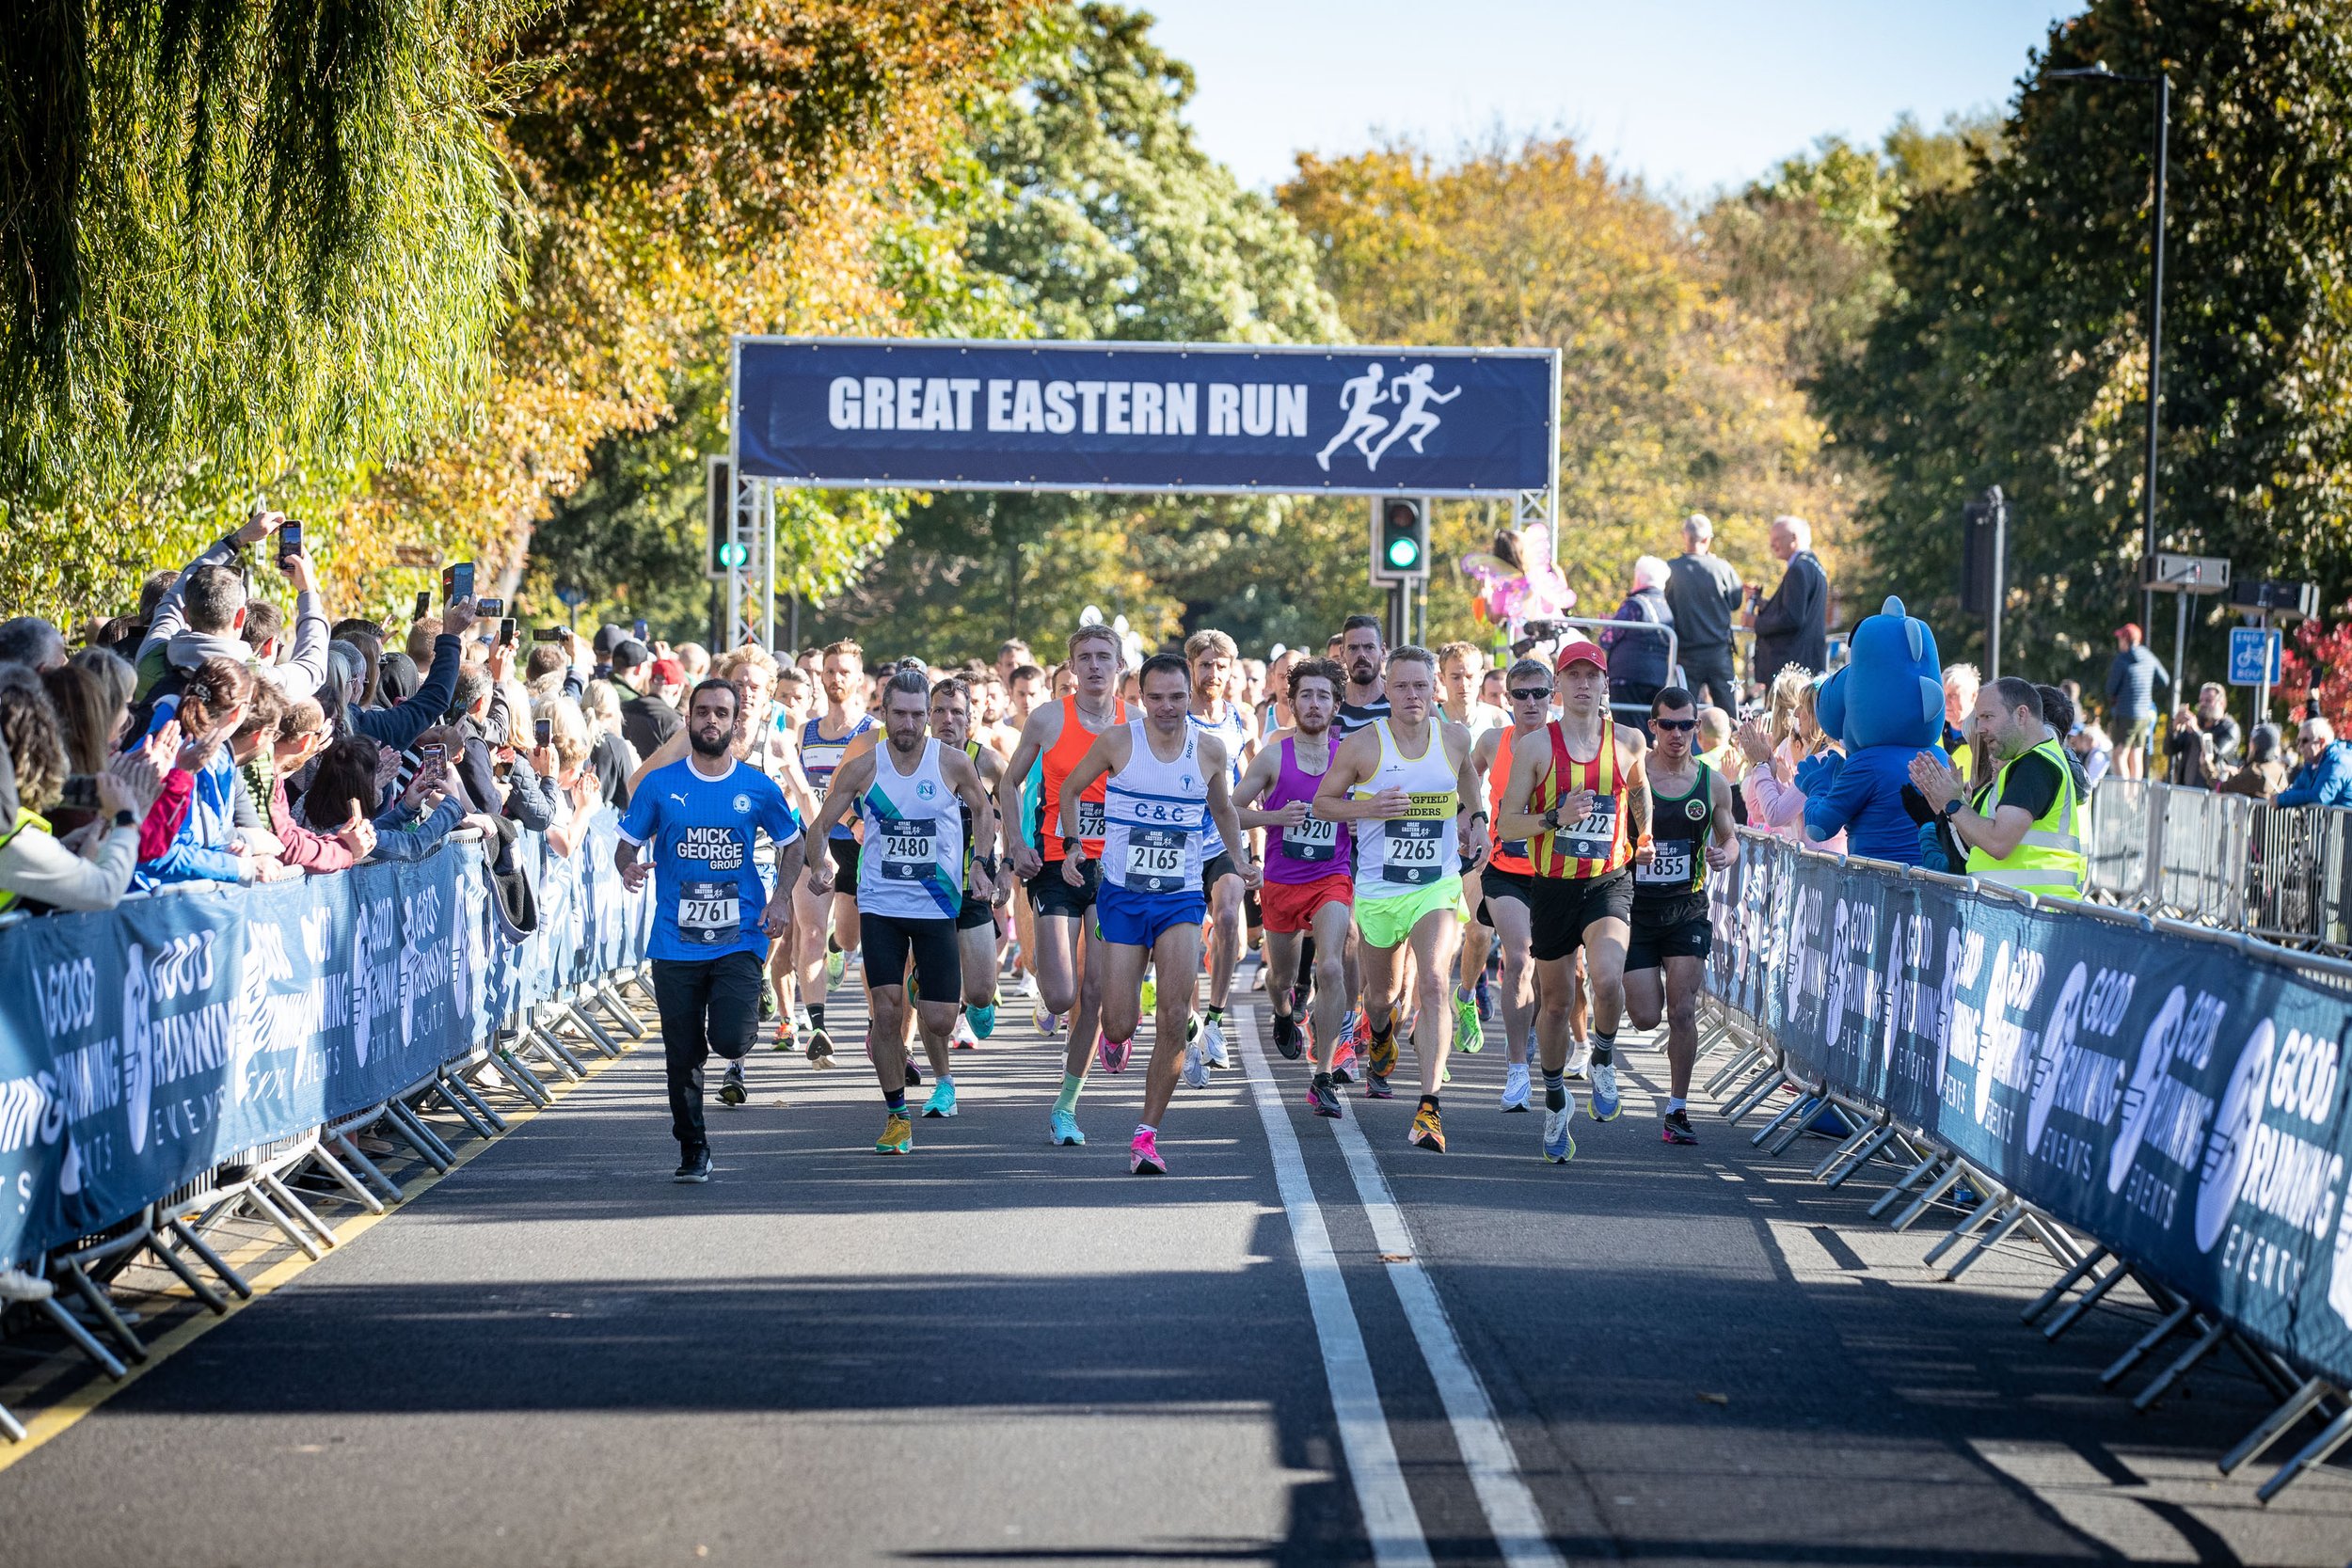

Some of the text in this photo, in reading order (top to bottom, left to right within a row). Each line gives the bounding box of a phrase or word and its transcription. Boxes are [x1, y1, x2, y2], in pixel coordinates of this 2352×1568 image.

[829, 376, 1308, 436] GREAT EASTERN RUN
[1185, 740, 1194, 759] soar
[1410, 796, 1449, 804] GFIELD
[1135, 802, 1184, 822] C & C
[1403, 807, 1441, 816] RIDERS
[687, 828, 731, 844] MICK
[1293, 819, 1331, 839] 1920
[677, 842, 743, 860] GEORGE
[887, 837, 929, 857] 2480
[1134, 847, 1179, 869] 2165
[1391, 839, 1436, 860] 2265
[709, 859, 742, 870] GROUP
[1646, 858, 1683, 875] 1855
[687, 901, 729, 922] 2761
[1851, 901, 1875, 954] GOOD
[1906, 914, 1932, 971] GOOD
[149, 928, 216, 1004] GOOD
[49, 957, 95, 1037] GOOD
[2082, 967, 2137, 1037] GOOD
[151, 997, 239, 1087] RUNNIN
[2053, 1045, 2126, 1126] RUNNING
[2270, 1028, 2339, 1125] GOOD
[2041, 1127, 2093, 1181] EVENTS
[2241, 1123, 2344, 1241] RUNNING
[2222, 1224, 2305, 1301] EVENTS
